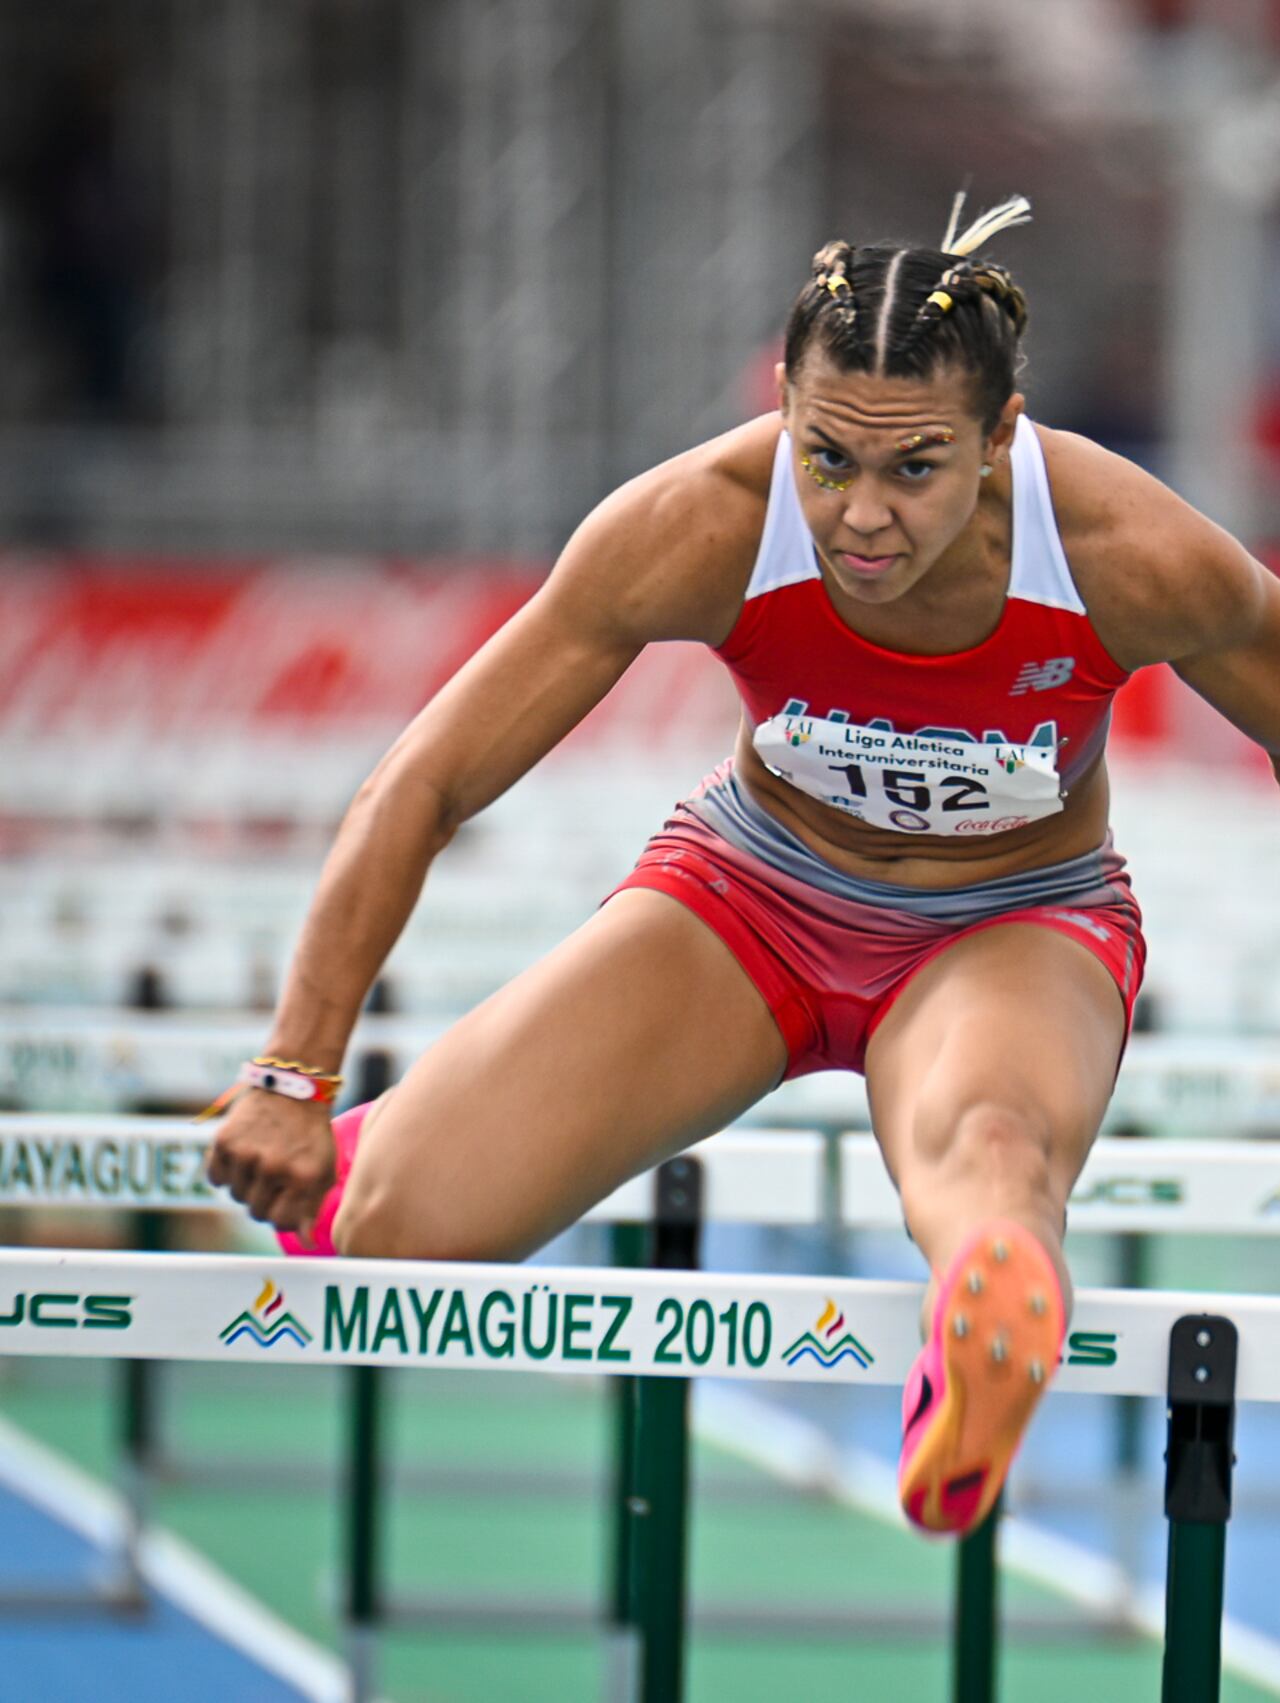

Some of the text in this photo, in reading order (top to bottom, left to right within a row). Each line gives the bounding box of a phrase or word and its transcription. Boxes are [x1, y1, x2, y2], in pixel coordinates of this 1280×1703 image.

[818, 745, 989, 776] Interuniversitaria
[845, 728, 964, 757] Liga Atletica
[828, 764, 990, 813] 152
[322, 1284, 633, 1363] MAYAGÜEZ
[653, 1298, 773, 1368] 2010
